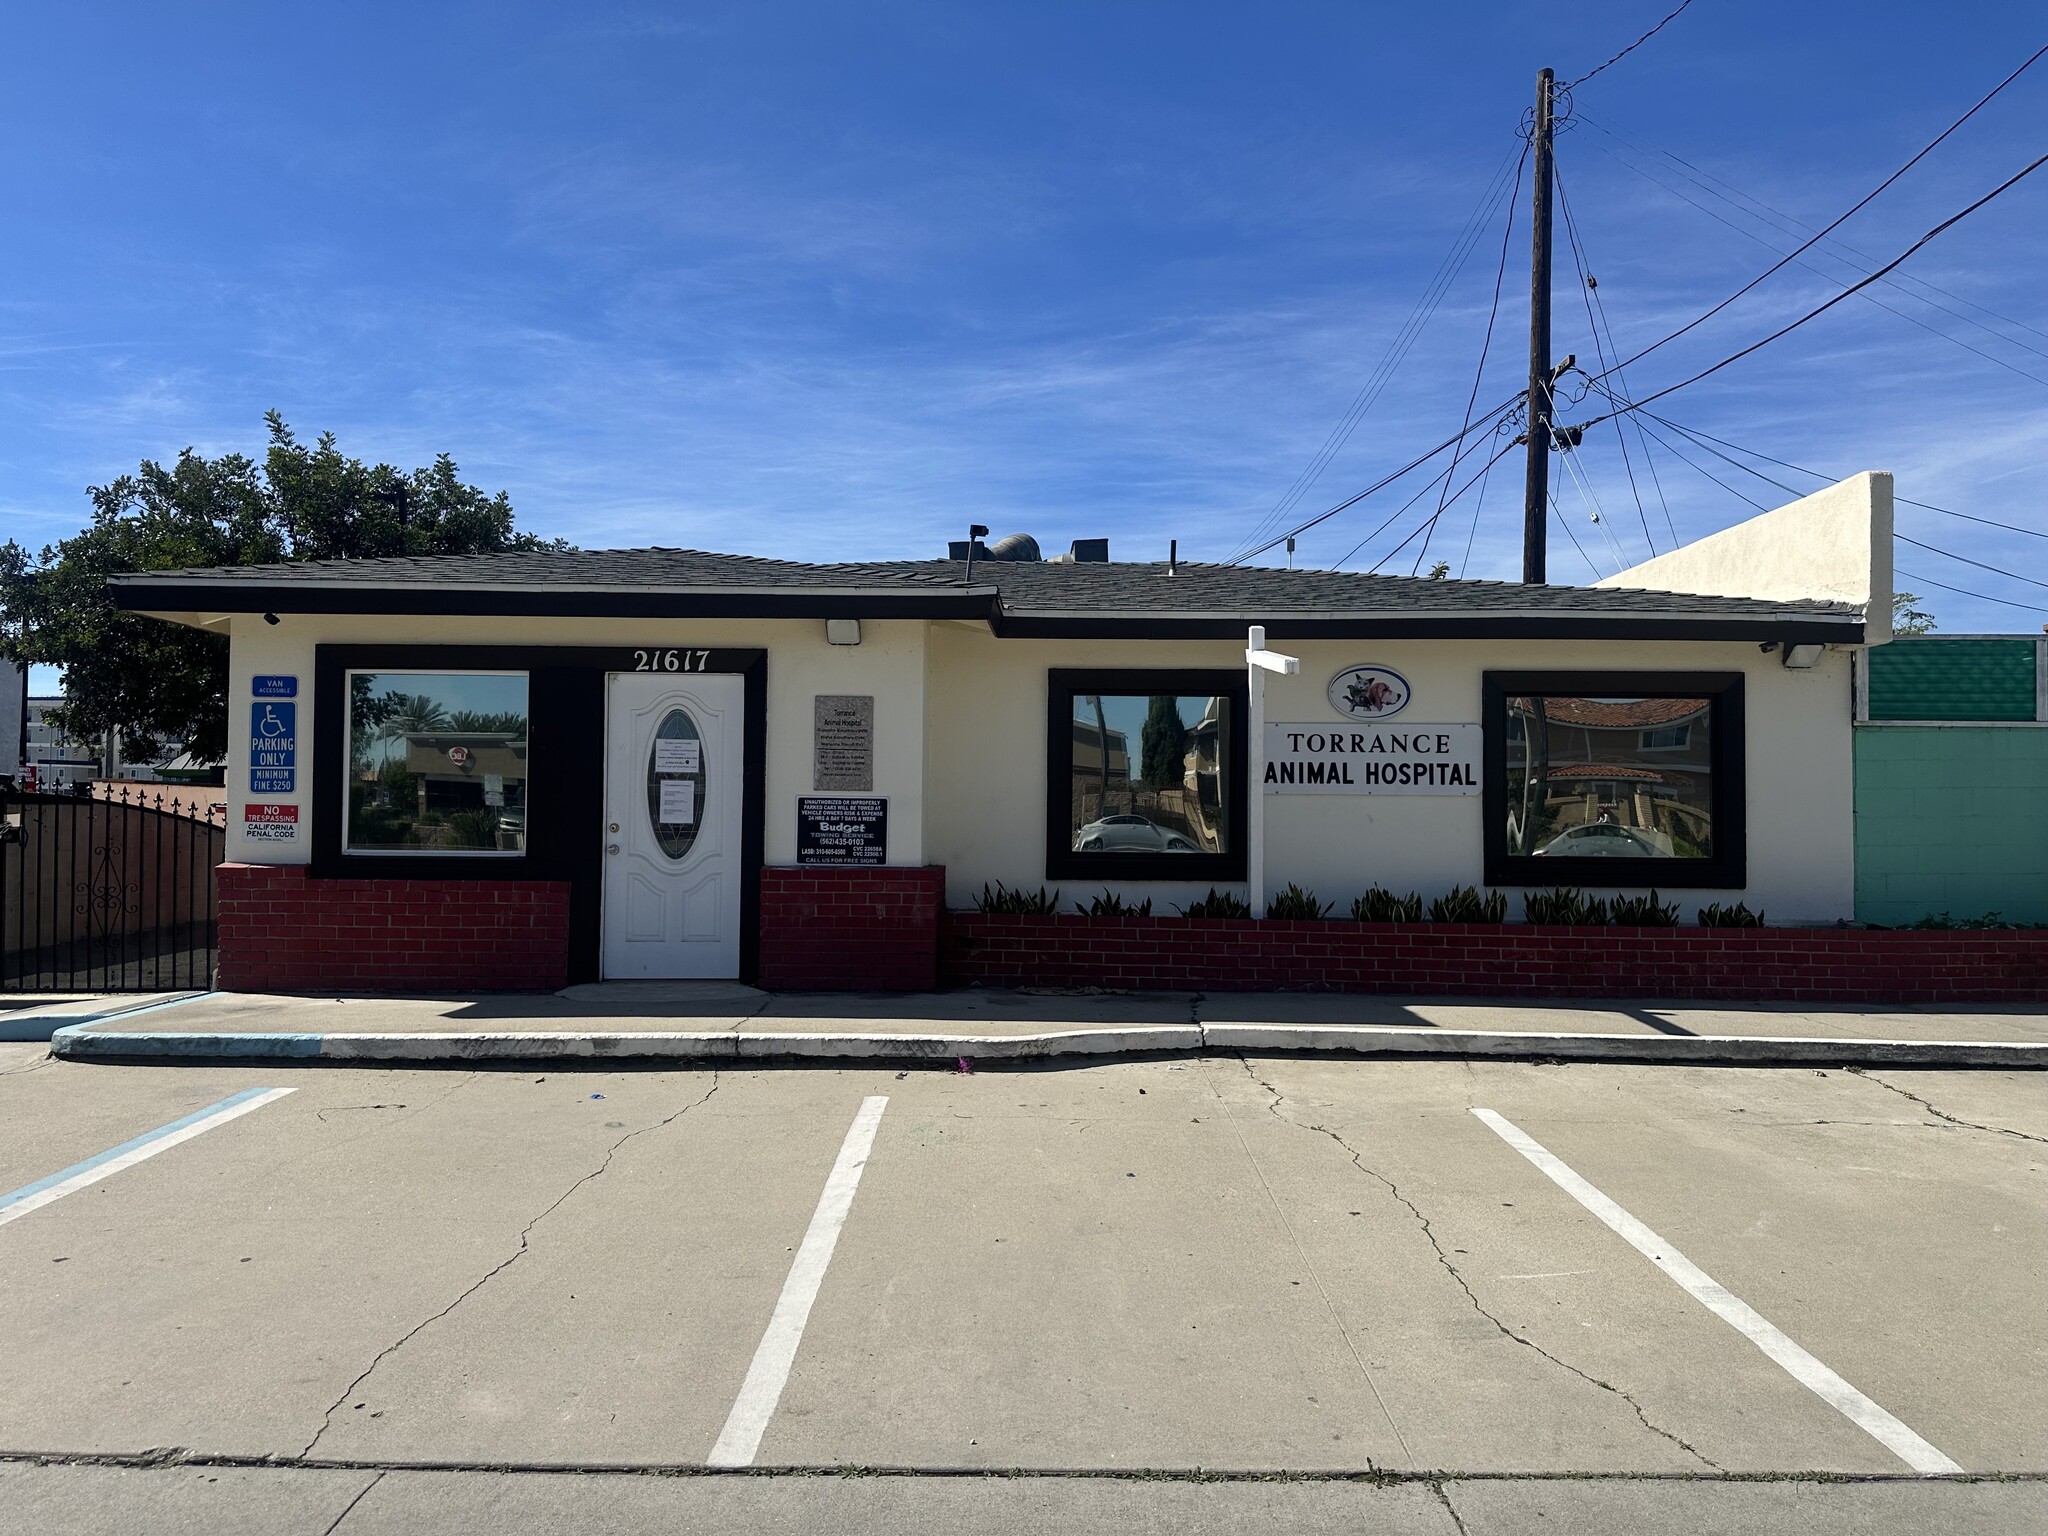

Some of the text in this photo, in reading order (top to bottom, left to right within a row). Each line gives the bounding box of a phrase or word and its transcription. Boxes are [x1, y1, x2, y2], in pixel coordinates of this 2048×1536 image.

[634, 650, 710, 672] 21617
[252, 738, 294, 750] PARKING
[1287, 733, 1450, 754] TORRANCE
[260, 752, 286, 766] ONLY
[256, 770, 289, 779] MINIMUM
[1264, 762, 1477, 786] ANIMAL HOSPITAL
[254, 780, 291, 790] FINE $250
[264, 806, 280, 815] NO
[819, 822, 866, 833] Budget
